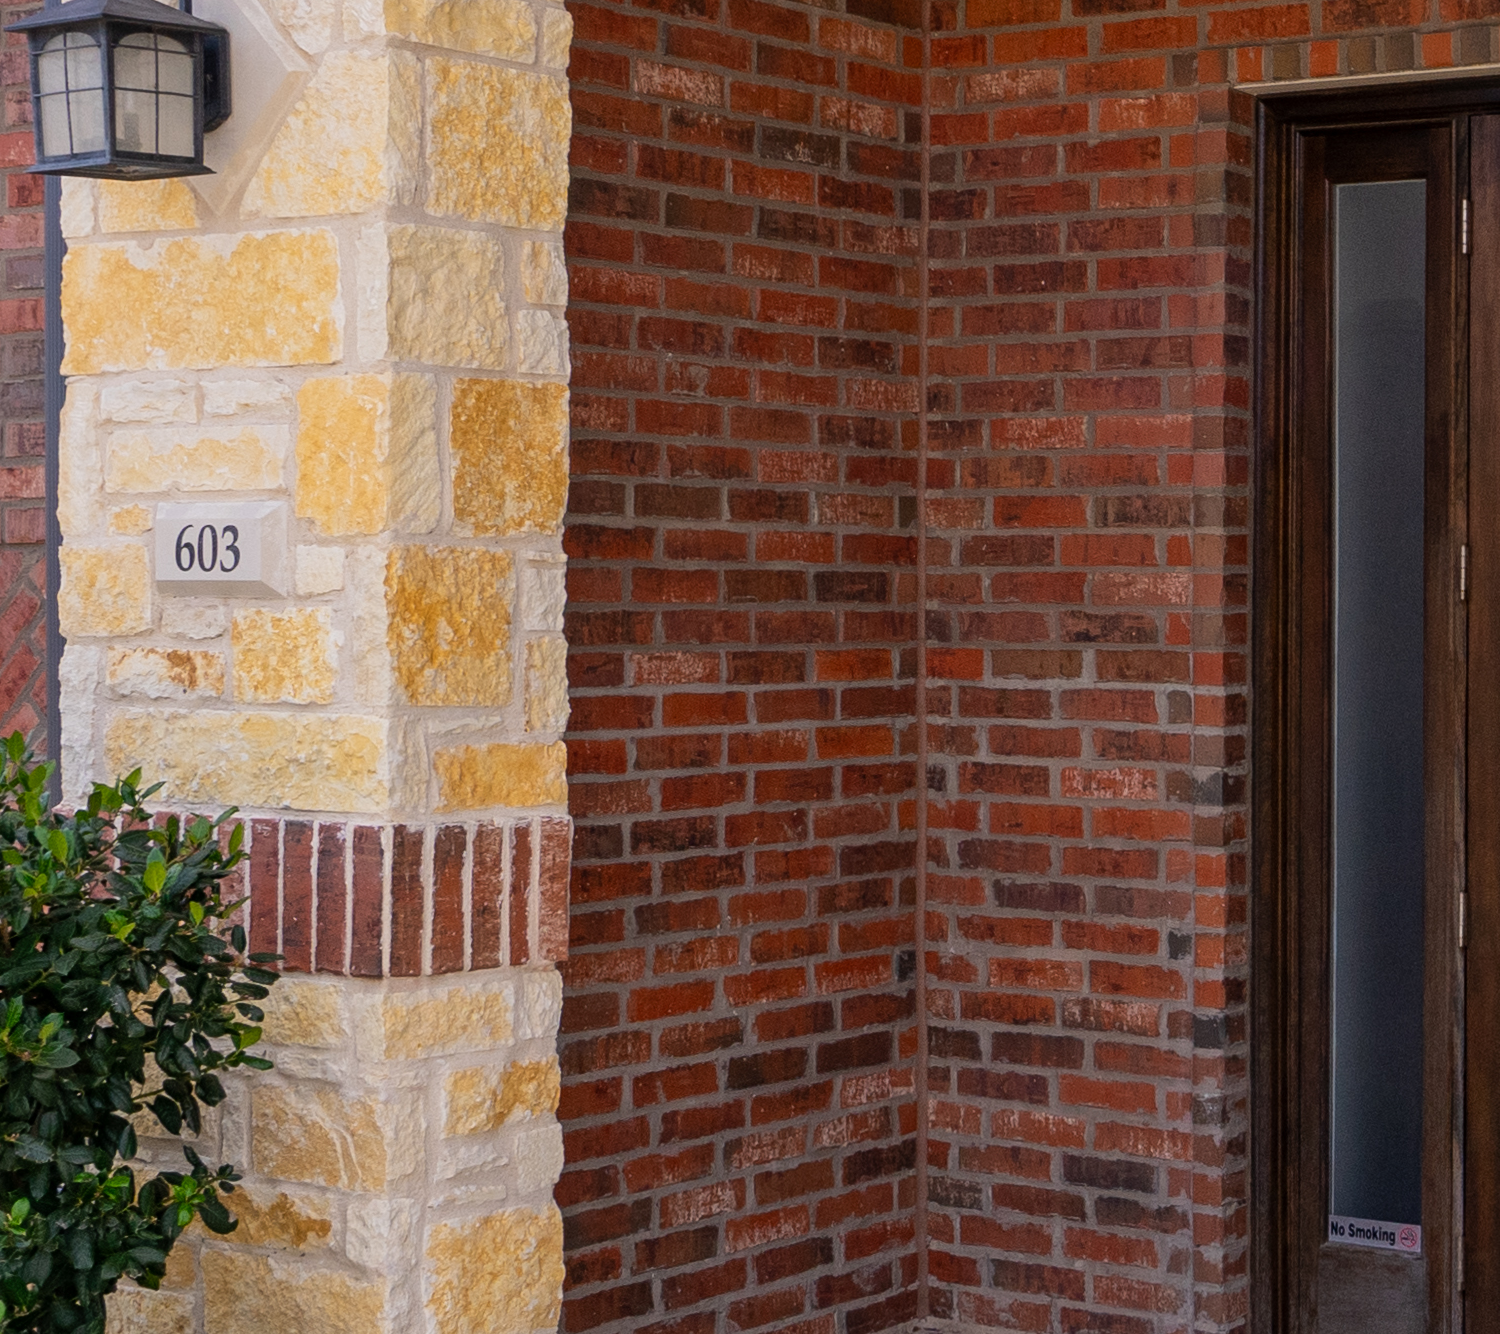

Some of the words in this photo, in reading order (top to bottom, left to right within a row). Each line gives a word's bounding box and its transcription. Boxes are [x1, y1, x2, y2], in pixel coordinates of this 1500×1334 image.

[175, 524, 241, 572] 603
[1330, 1221, 1345, 1236] No
[1348, 1223, 1396, 1246] Smoking
